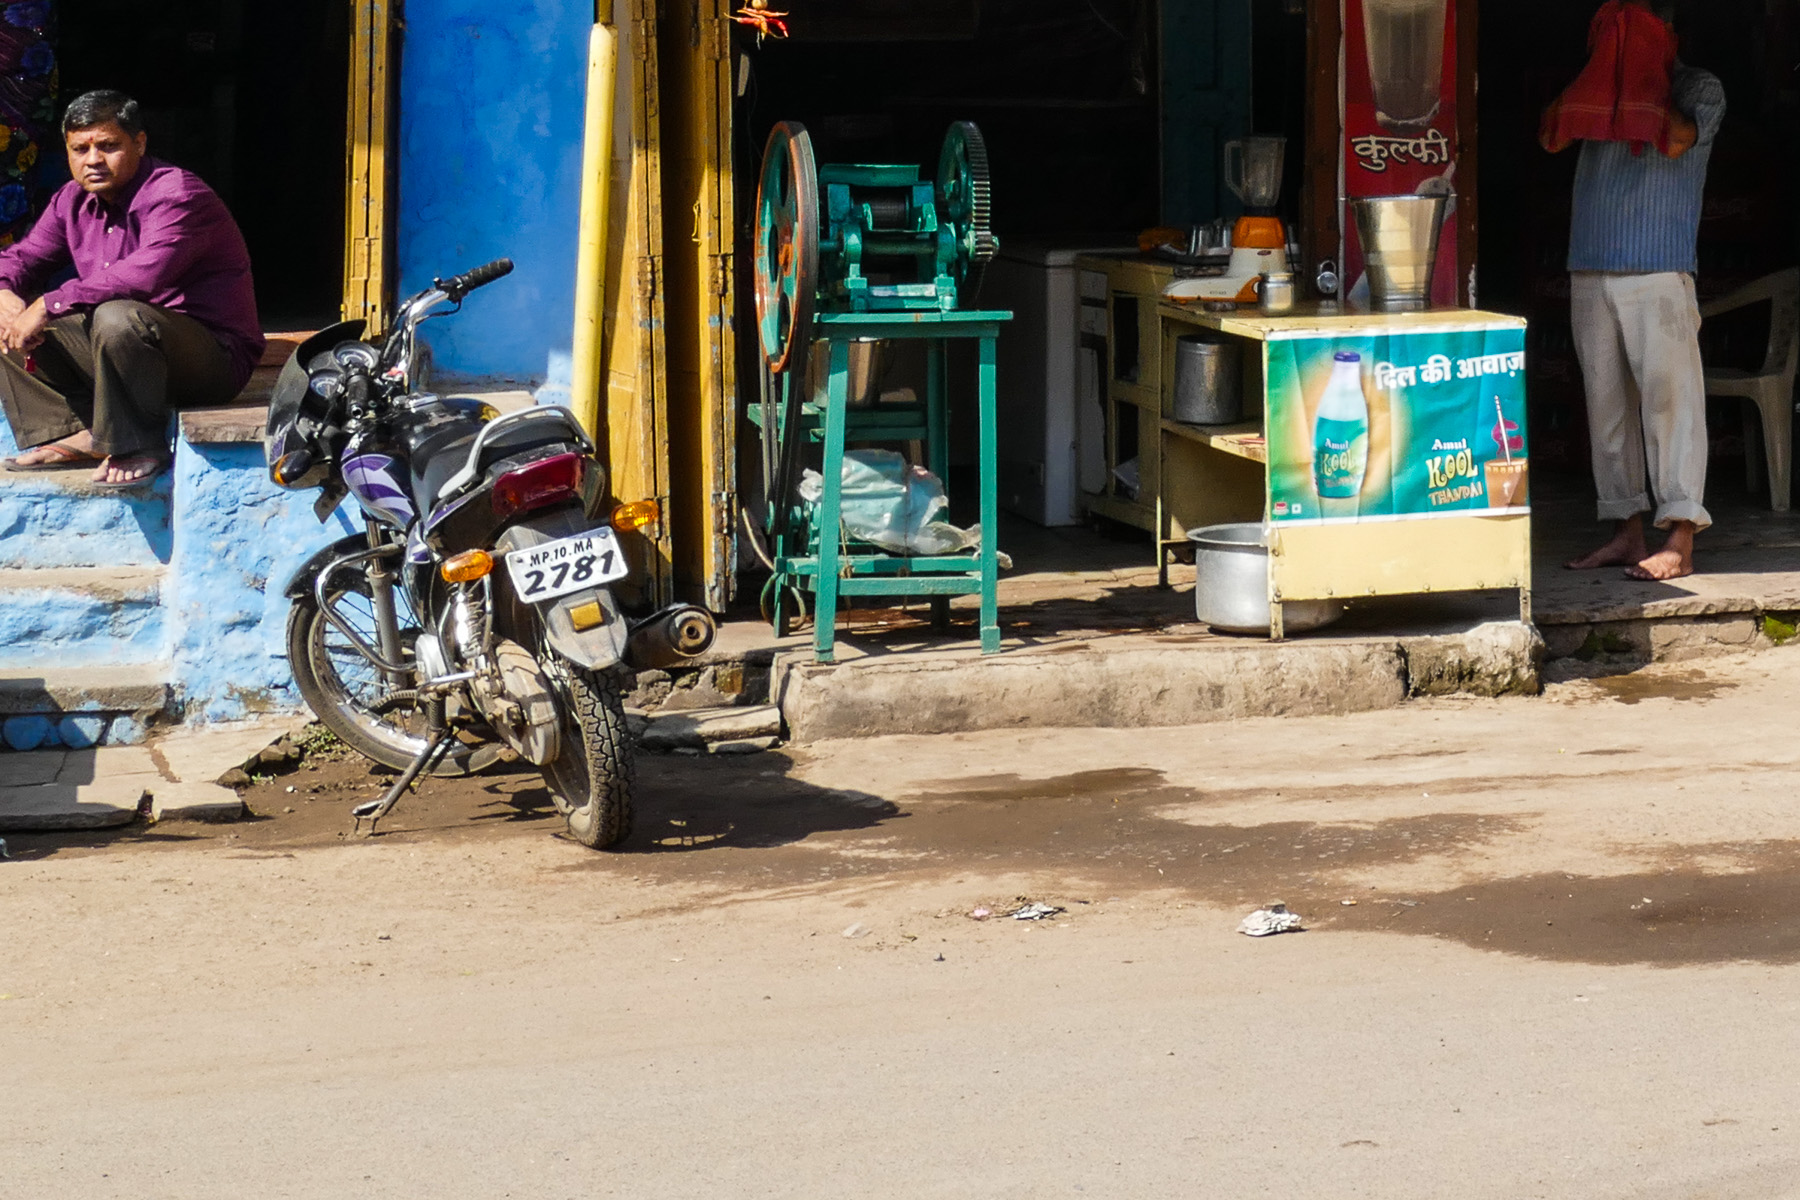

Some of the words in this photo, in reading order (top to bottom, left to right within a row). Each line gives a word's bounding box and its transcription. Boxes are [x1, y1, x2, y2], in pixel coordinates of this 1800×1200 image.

[1351, 128, 1449, 172] कुल्फी
[1374, 361, 1416, 390] दिल
[1419, 354, 1451, 384] की
[1324, 437, 1350, 450] Amul
[1431, 438, 1467, 450] Amul
[1320, 449, 1357, 477] KOOL
[1425, 448, 1479, 489] KOOL
[1428, 481, 1484, 507] THANDAI
[524, 550, 615, 596] 2781
